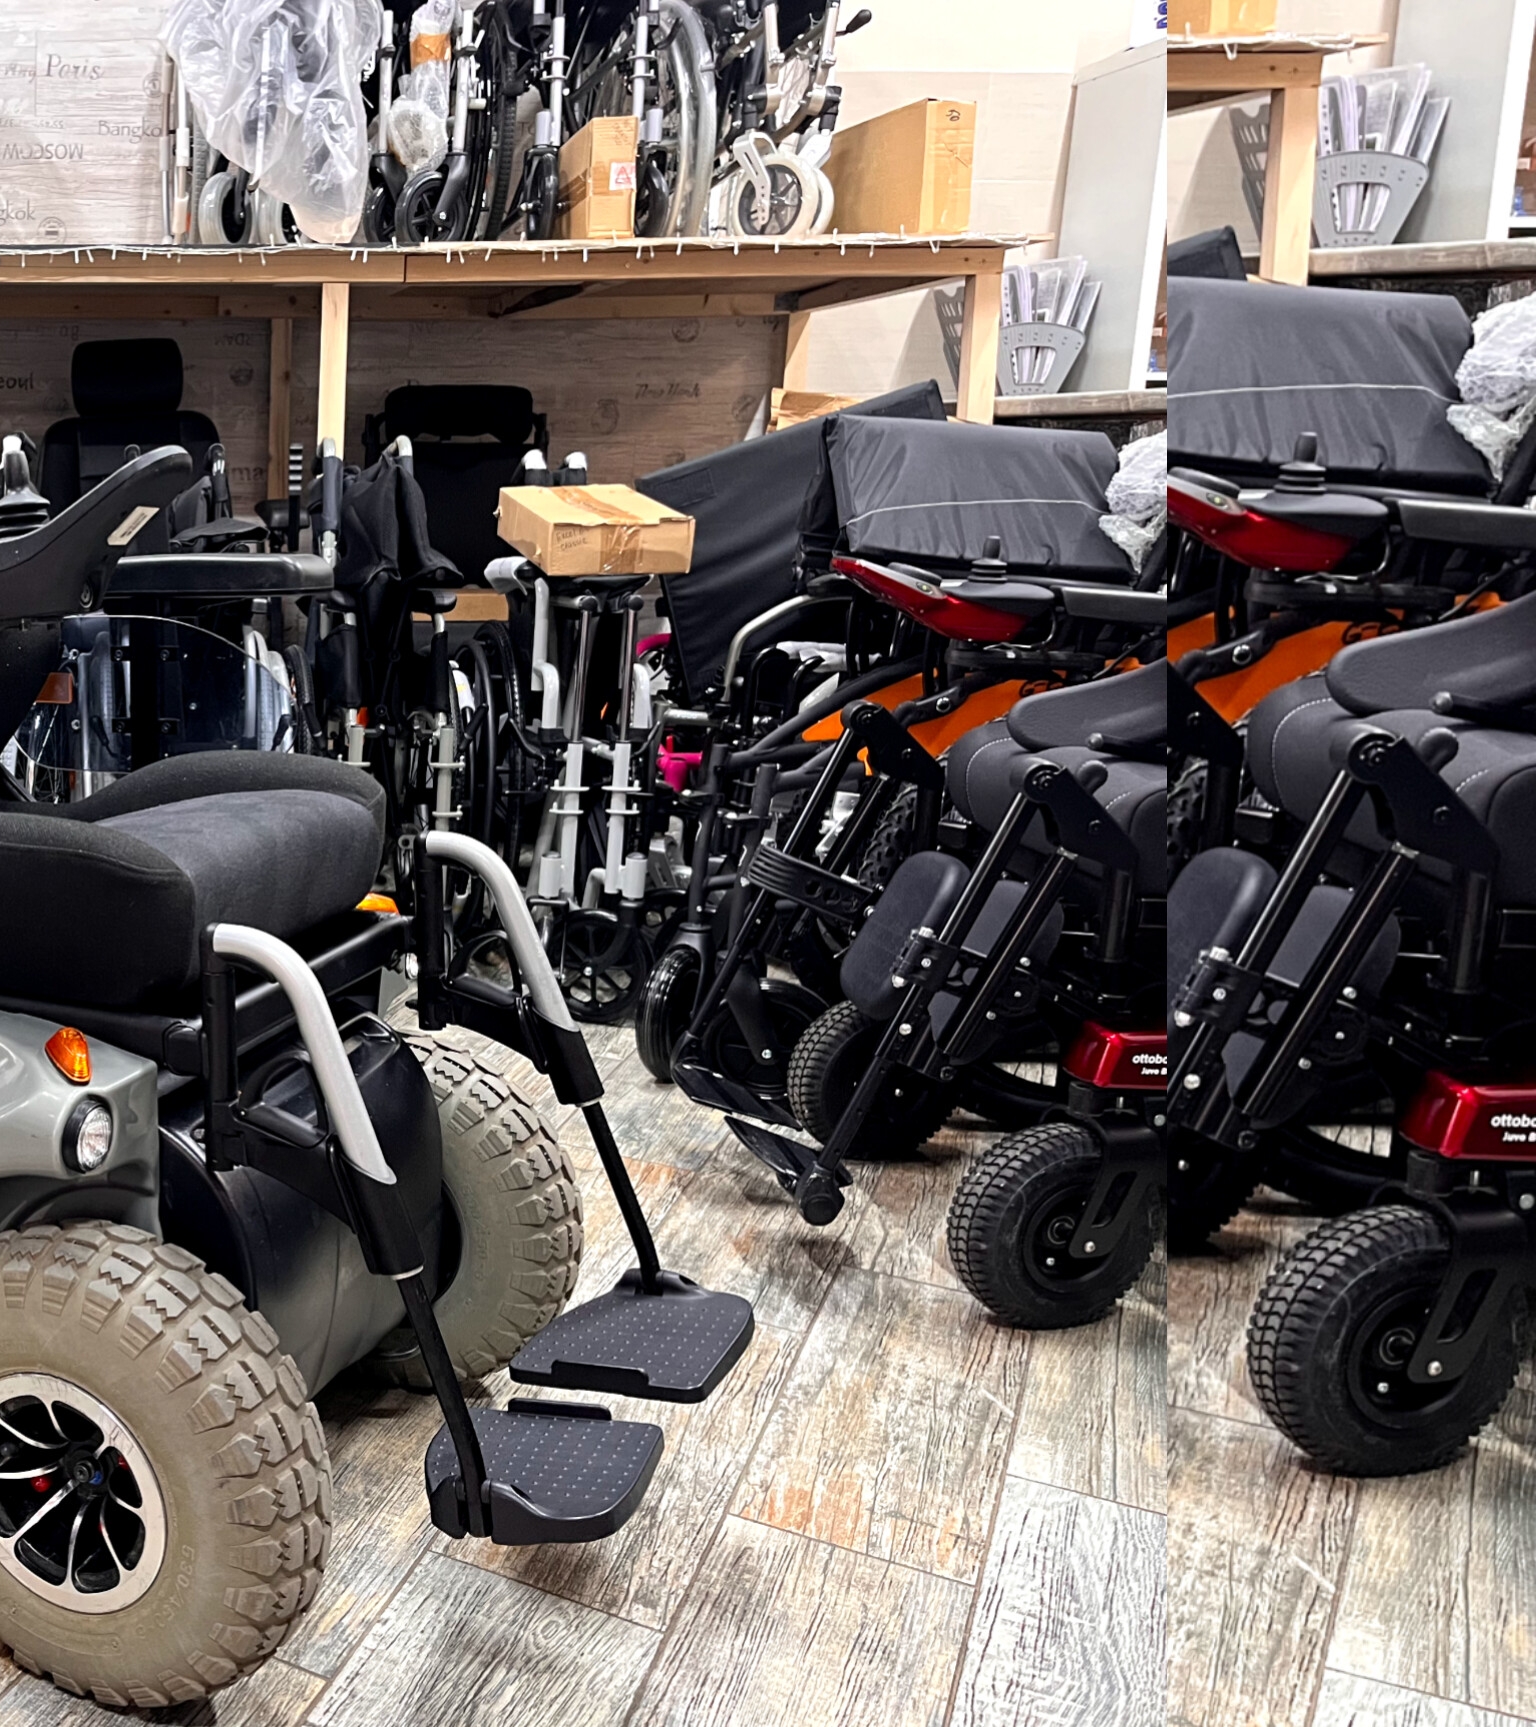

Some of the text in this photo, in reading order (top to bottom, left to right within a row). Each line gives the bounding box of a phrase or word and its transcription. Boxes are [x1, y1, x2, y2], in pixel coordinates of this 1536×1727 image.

[45, 53, 107, 81] Paris
[97, 117, 163, 144] Bangko
[2, 143, 84, 160] MOSCOW
